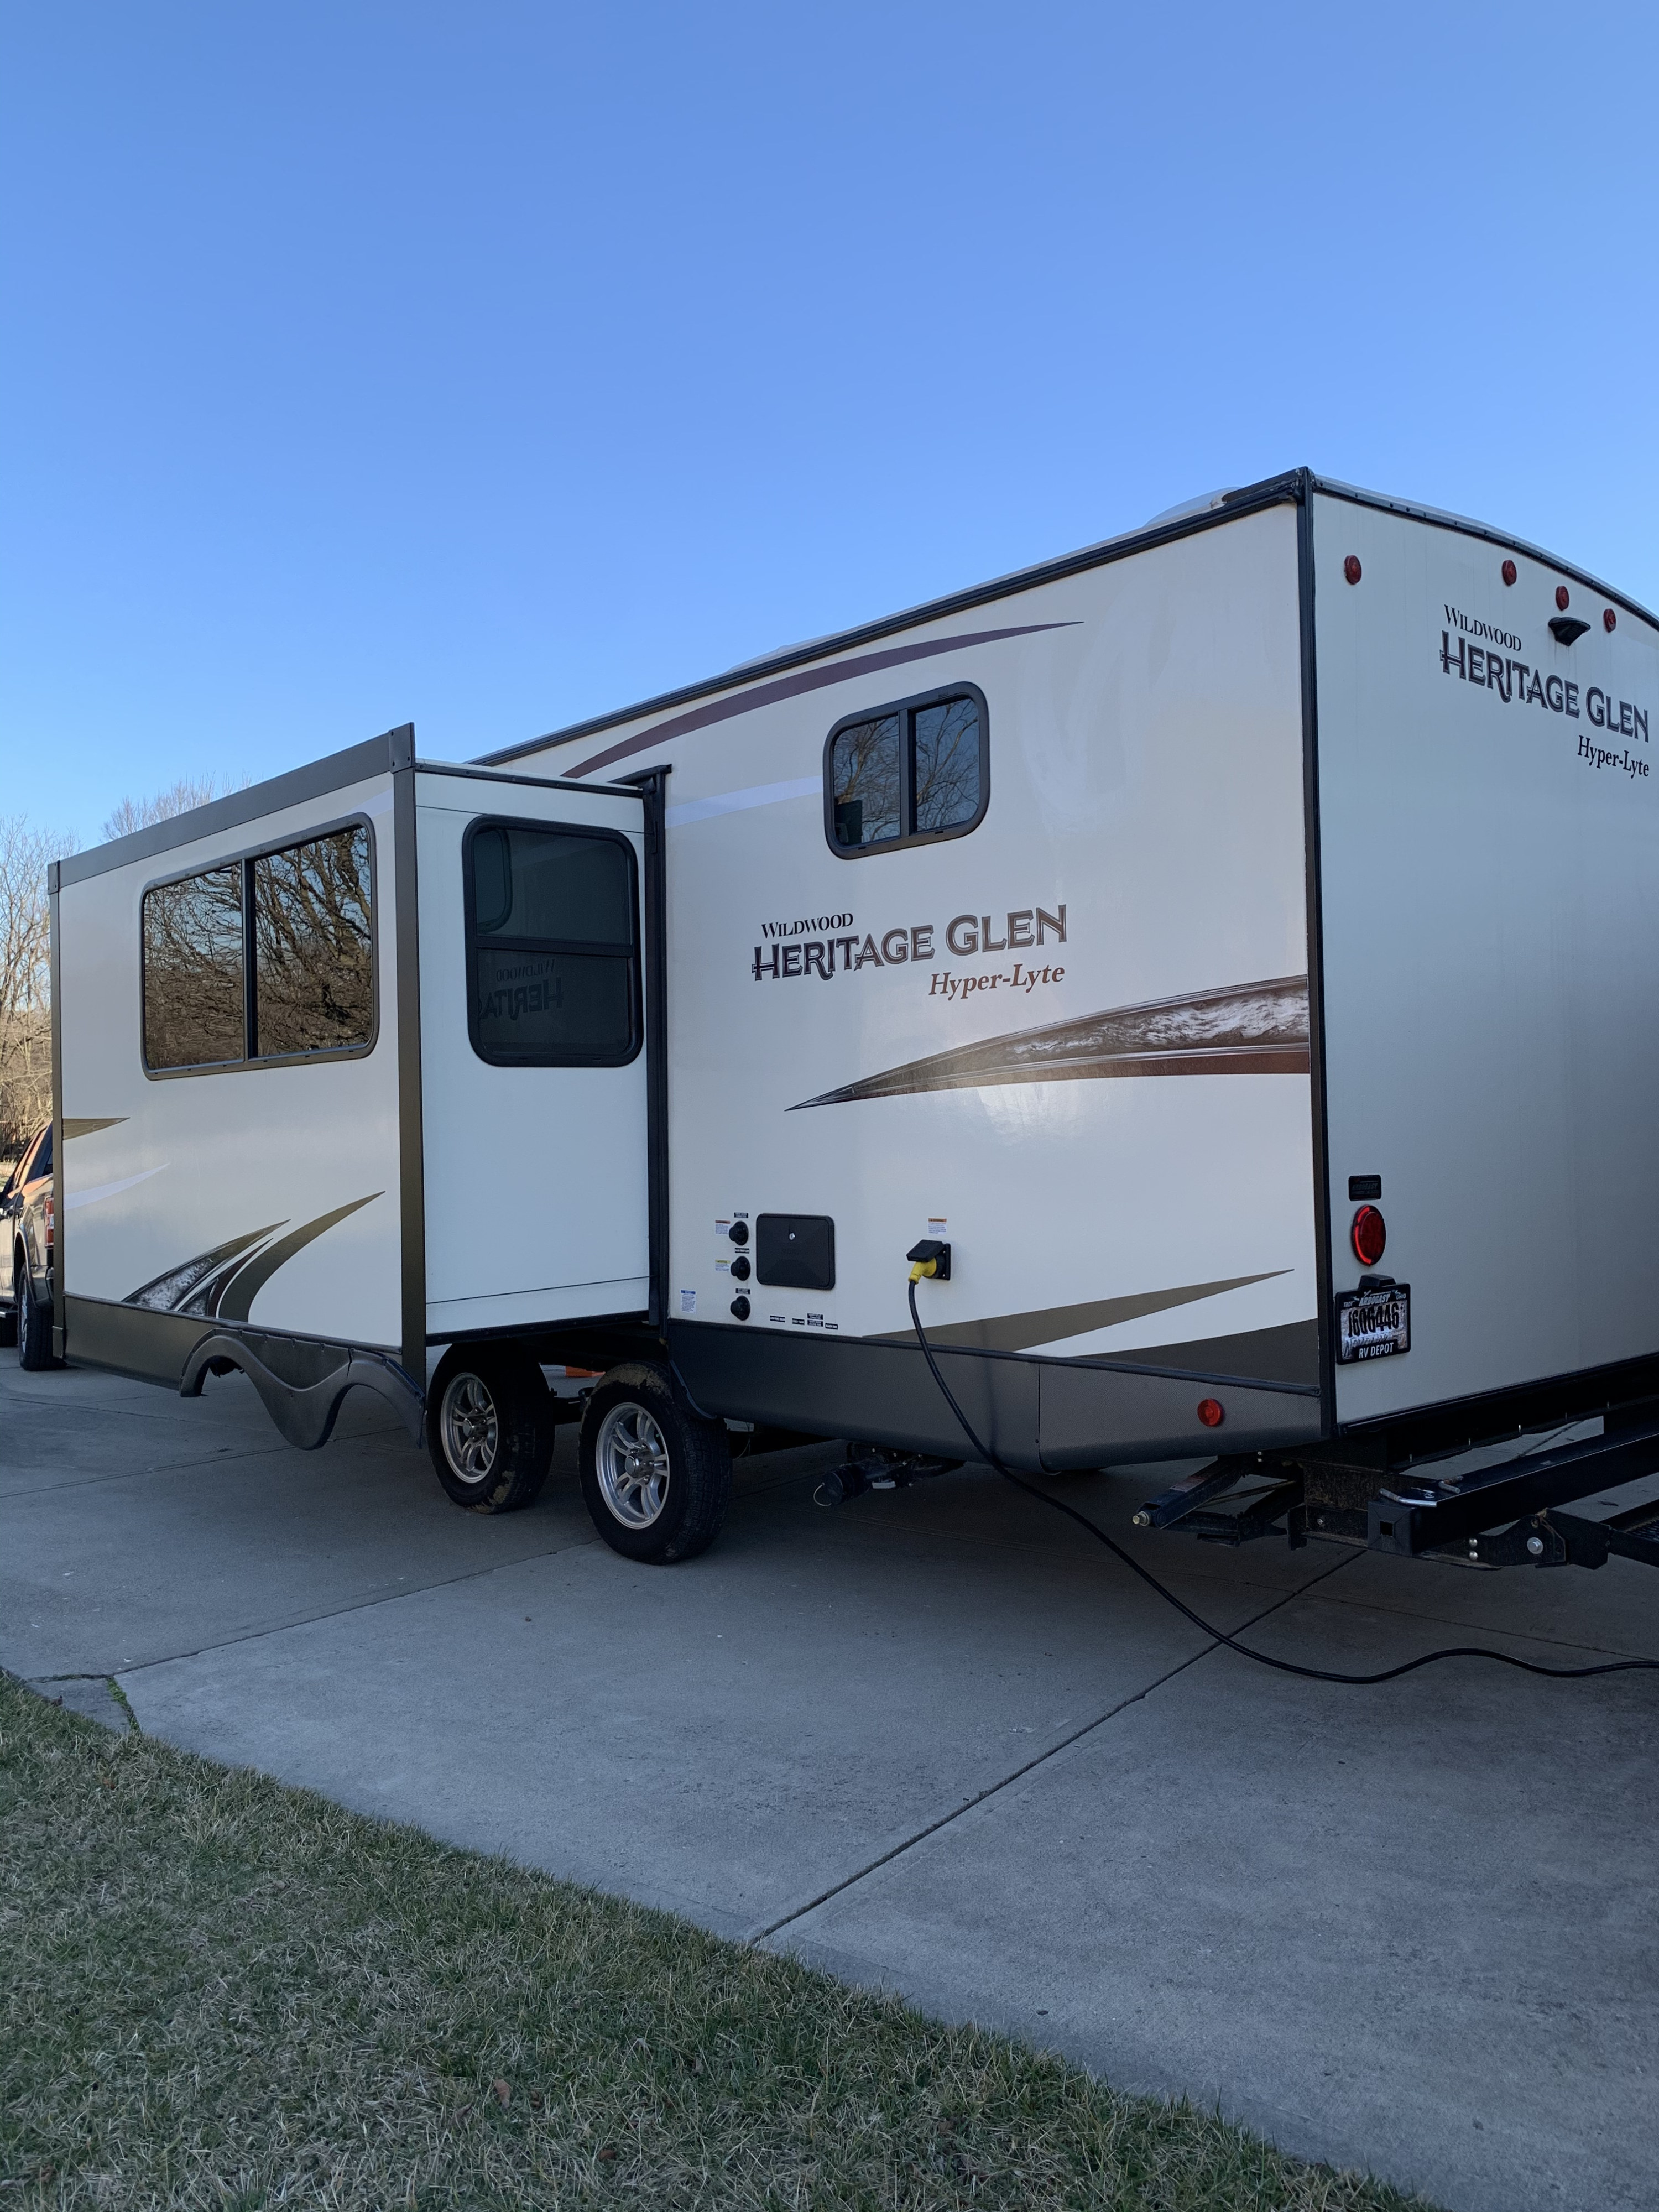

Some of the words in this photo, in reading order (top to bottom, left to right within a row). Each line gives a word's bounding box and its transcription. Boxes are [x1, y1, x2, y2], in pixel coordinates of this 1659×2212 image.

[1443, 604, 1522, 651] WILDWOOD
[1439, 630, 1580, 719] HERITAGE
[1585, 686, 1649, 743] GLEN
[1577, 734, 1650, 779] Hyper-Lyte
[751, 925, 936, 982] HERITAGE
[945, 904, 1067, 956] GLEN
[761, 912, 854, 938] WILDWOOD
[928, 963, 1065, 1001] Hyper-Lyte
[1359, 1293, 1391, 1306] ARBOGAST
[1359, 1347, 1369, 1359] RV
[1370, 1342, 1394, 1356] DEPOT
